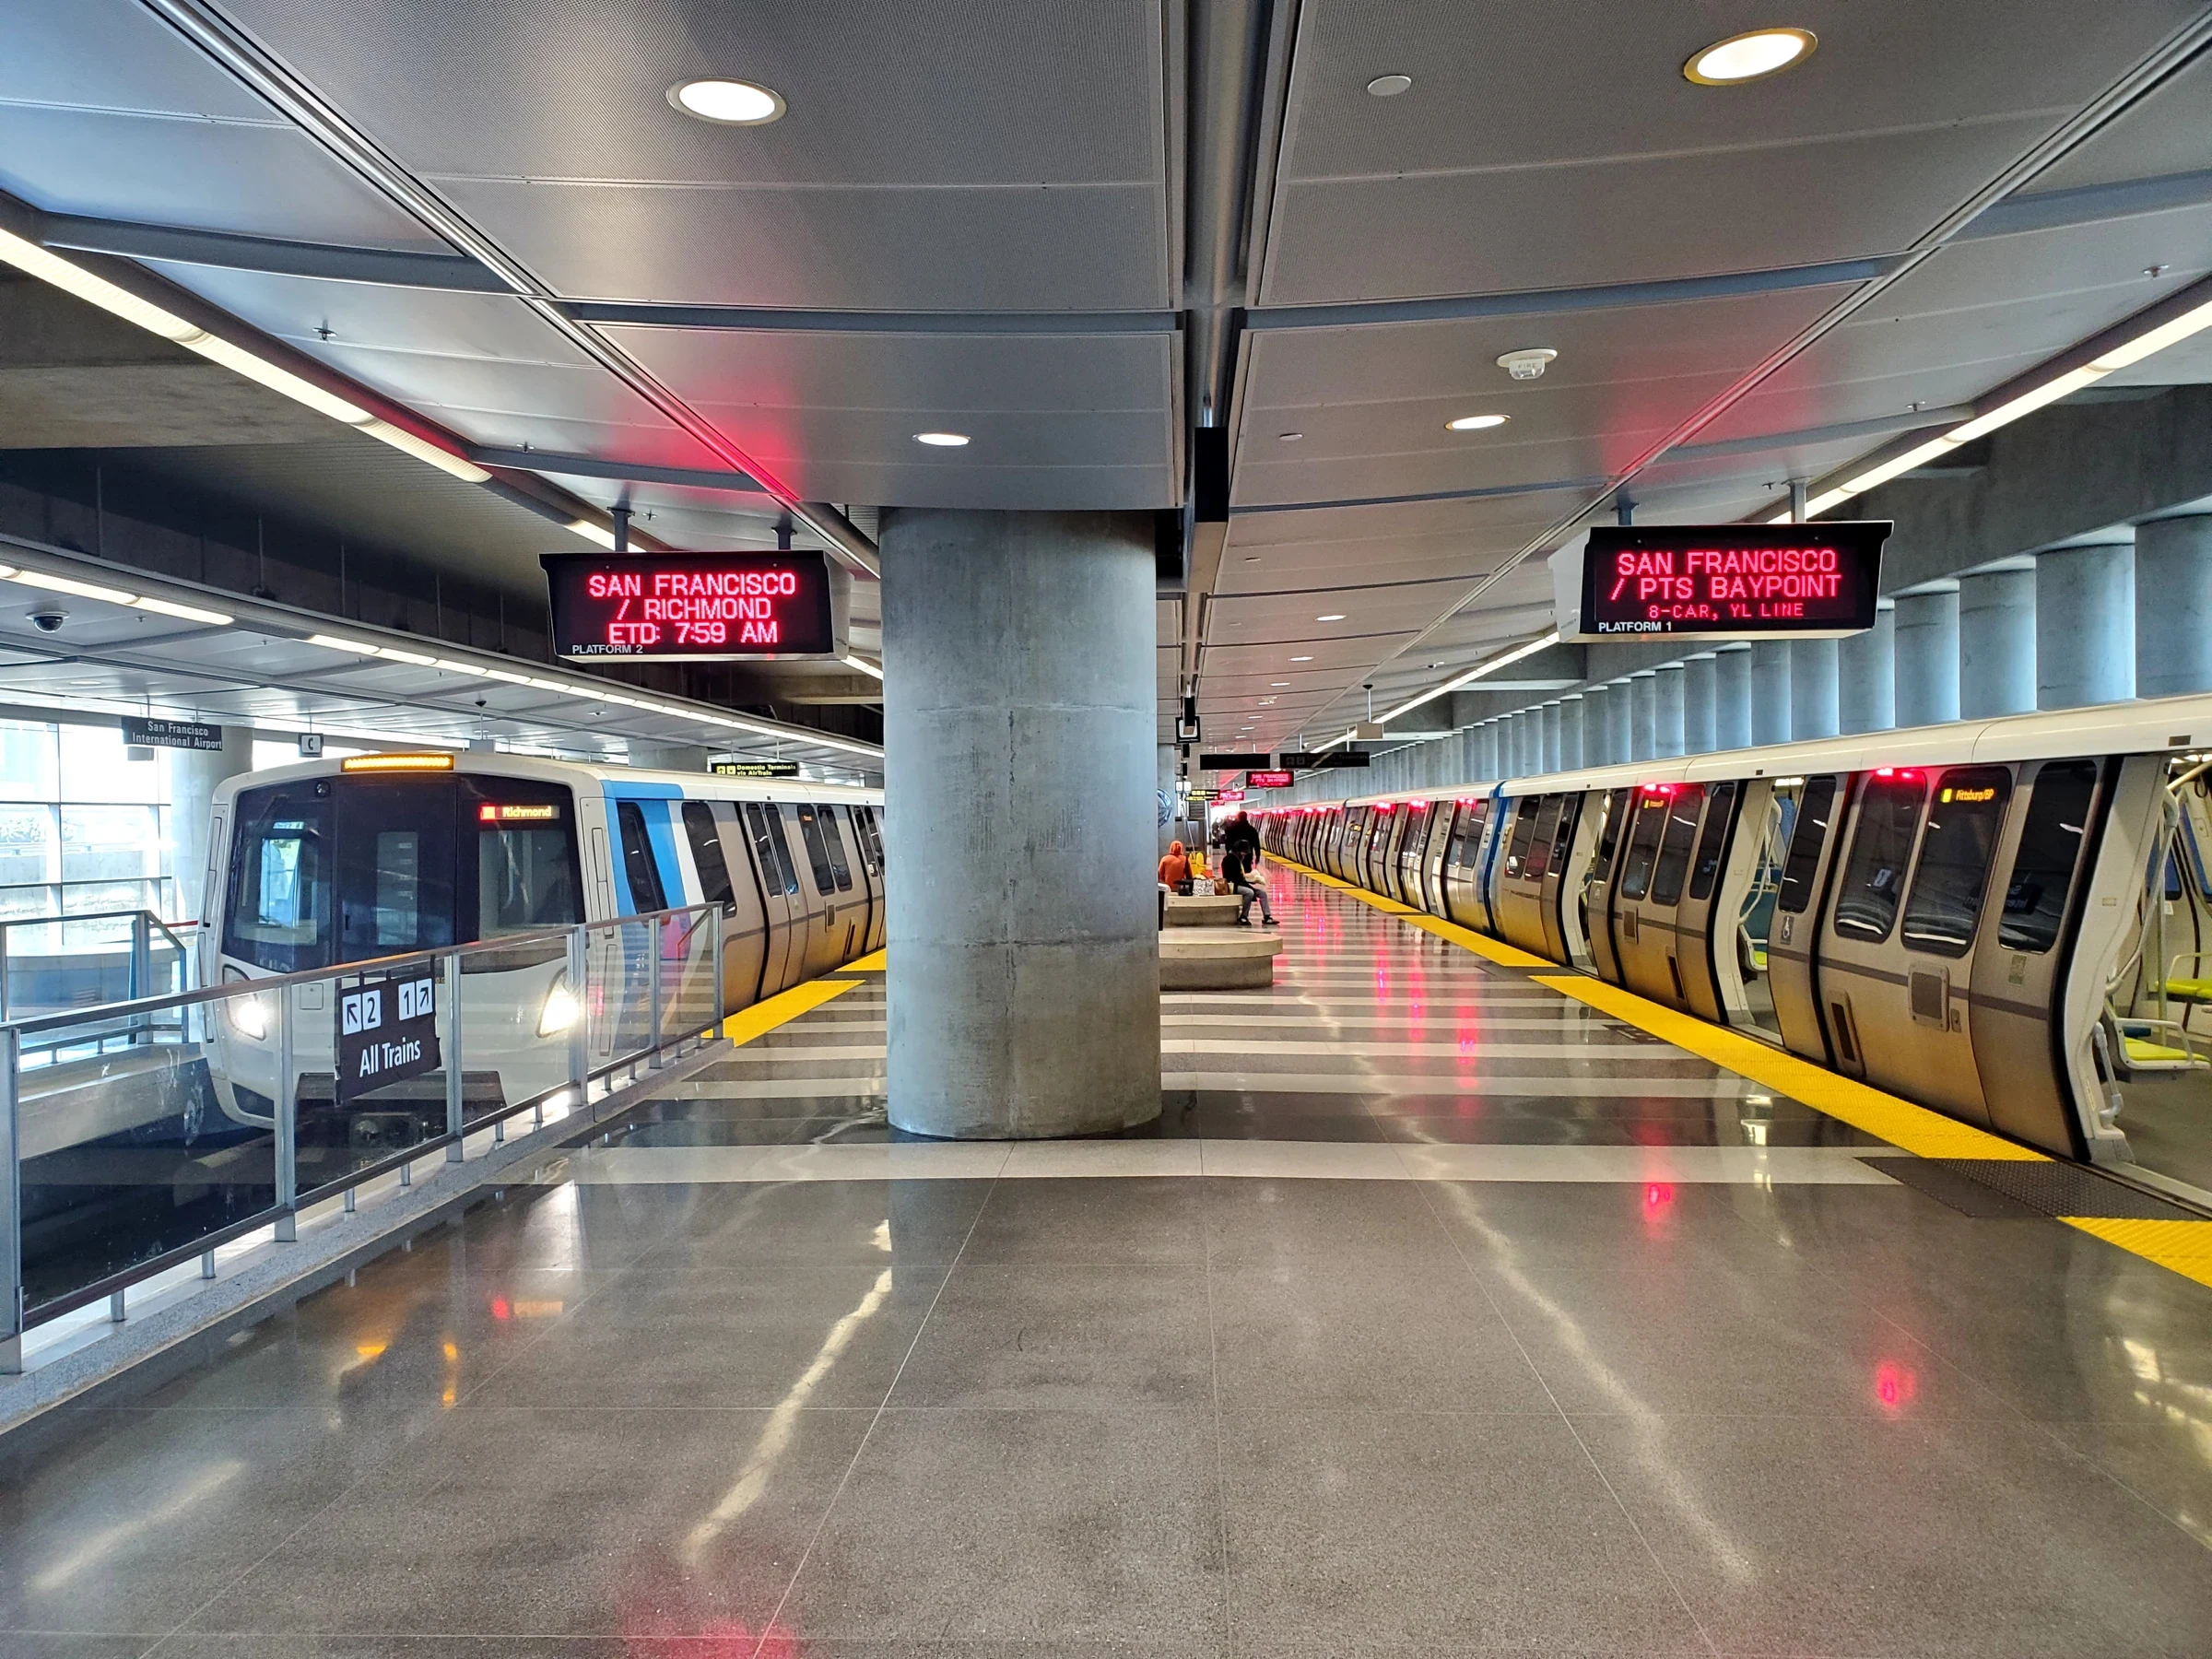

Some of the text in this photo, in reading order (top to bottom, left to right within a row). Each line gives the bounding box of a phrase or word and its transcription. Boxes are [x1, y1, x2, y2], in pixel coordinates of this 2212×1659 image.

[1618, 549, 1836, 576] SAN FRANCISCO
[589, 572, 795, 597] SAN FRANCISCO
[1611, 574, 1841, 601] / PTS BAYPOINT
[616, 598, 771, 620] / RICHMOND
[1649, 603, 1804, 620] 8-CAR, YL LINE
[608, 621, 778, 644] ETD: 7:59 AM
[1598, 621, 1672, 632] PLATFORM 1
[572, 644, 643, 654] PLATFORM 2
[147, 721, 208, 736] San Francisco
[132, 733, 222, 751] International Airport
[308, 738, 314, 750] C
[502, 806, 552, 818] Richmond
[367, 990, 410, 1024] 2 1
[359, 1036, 421, 1078] All Trains
